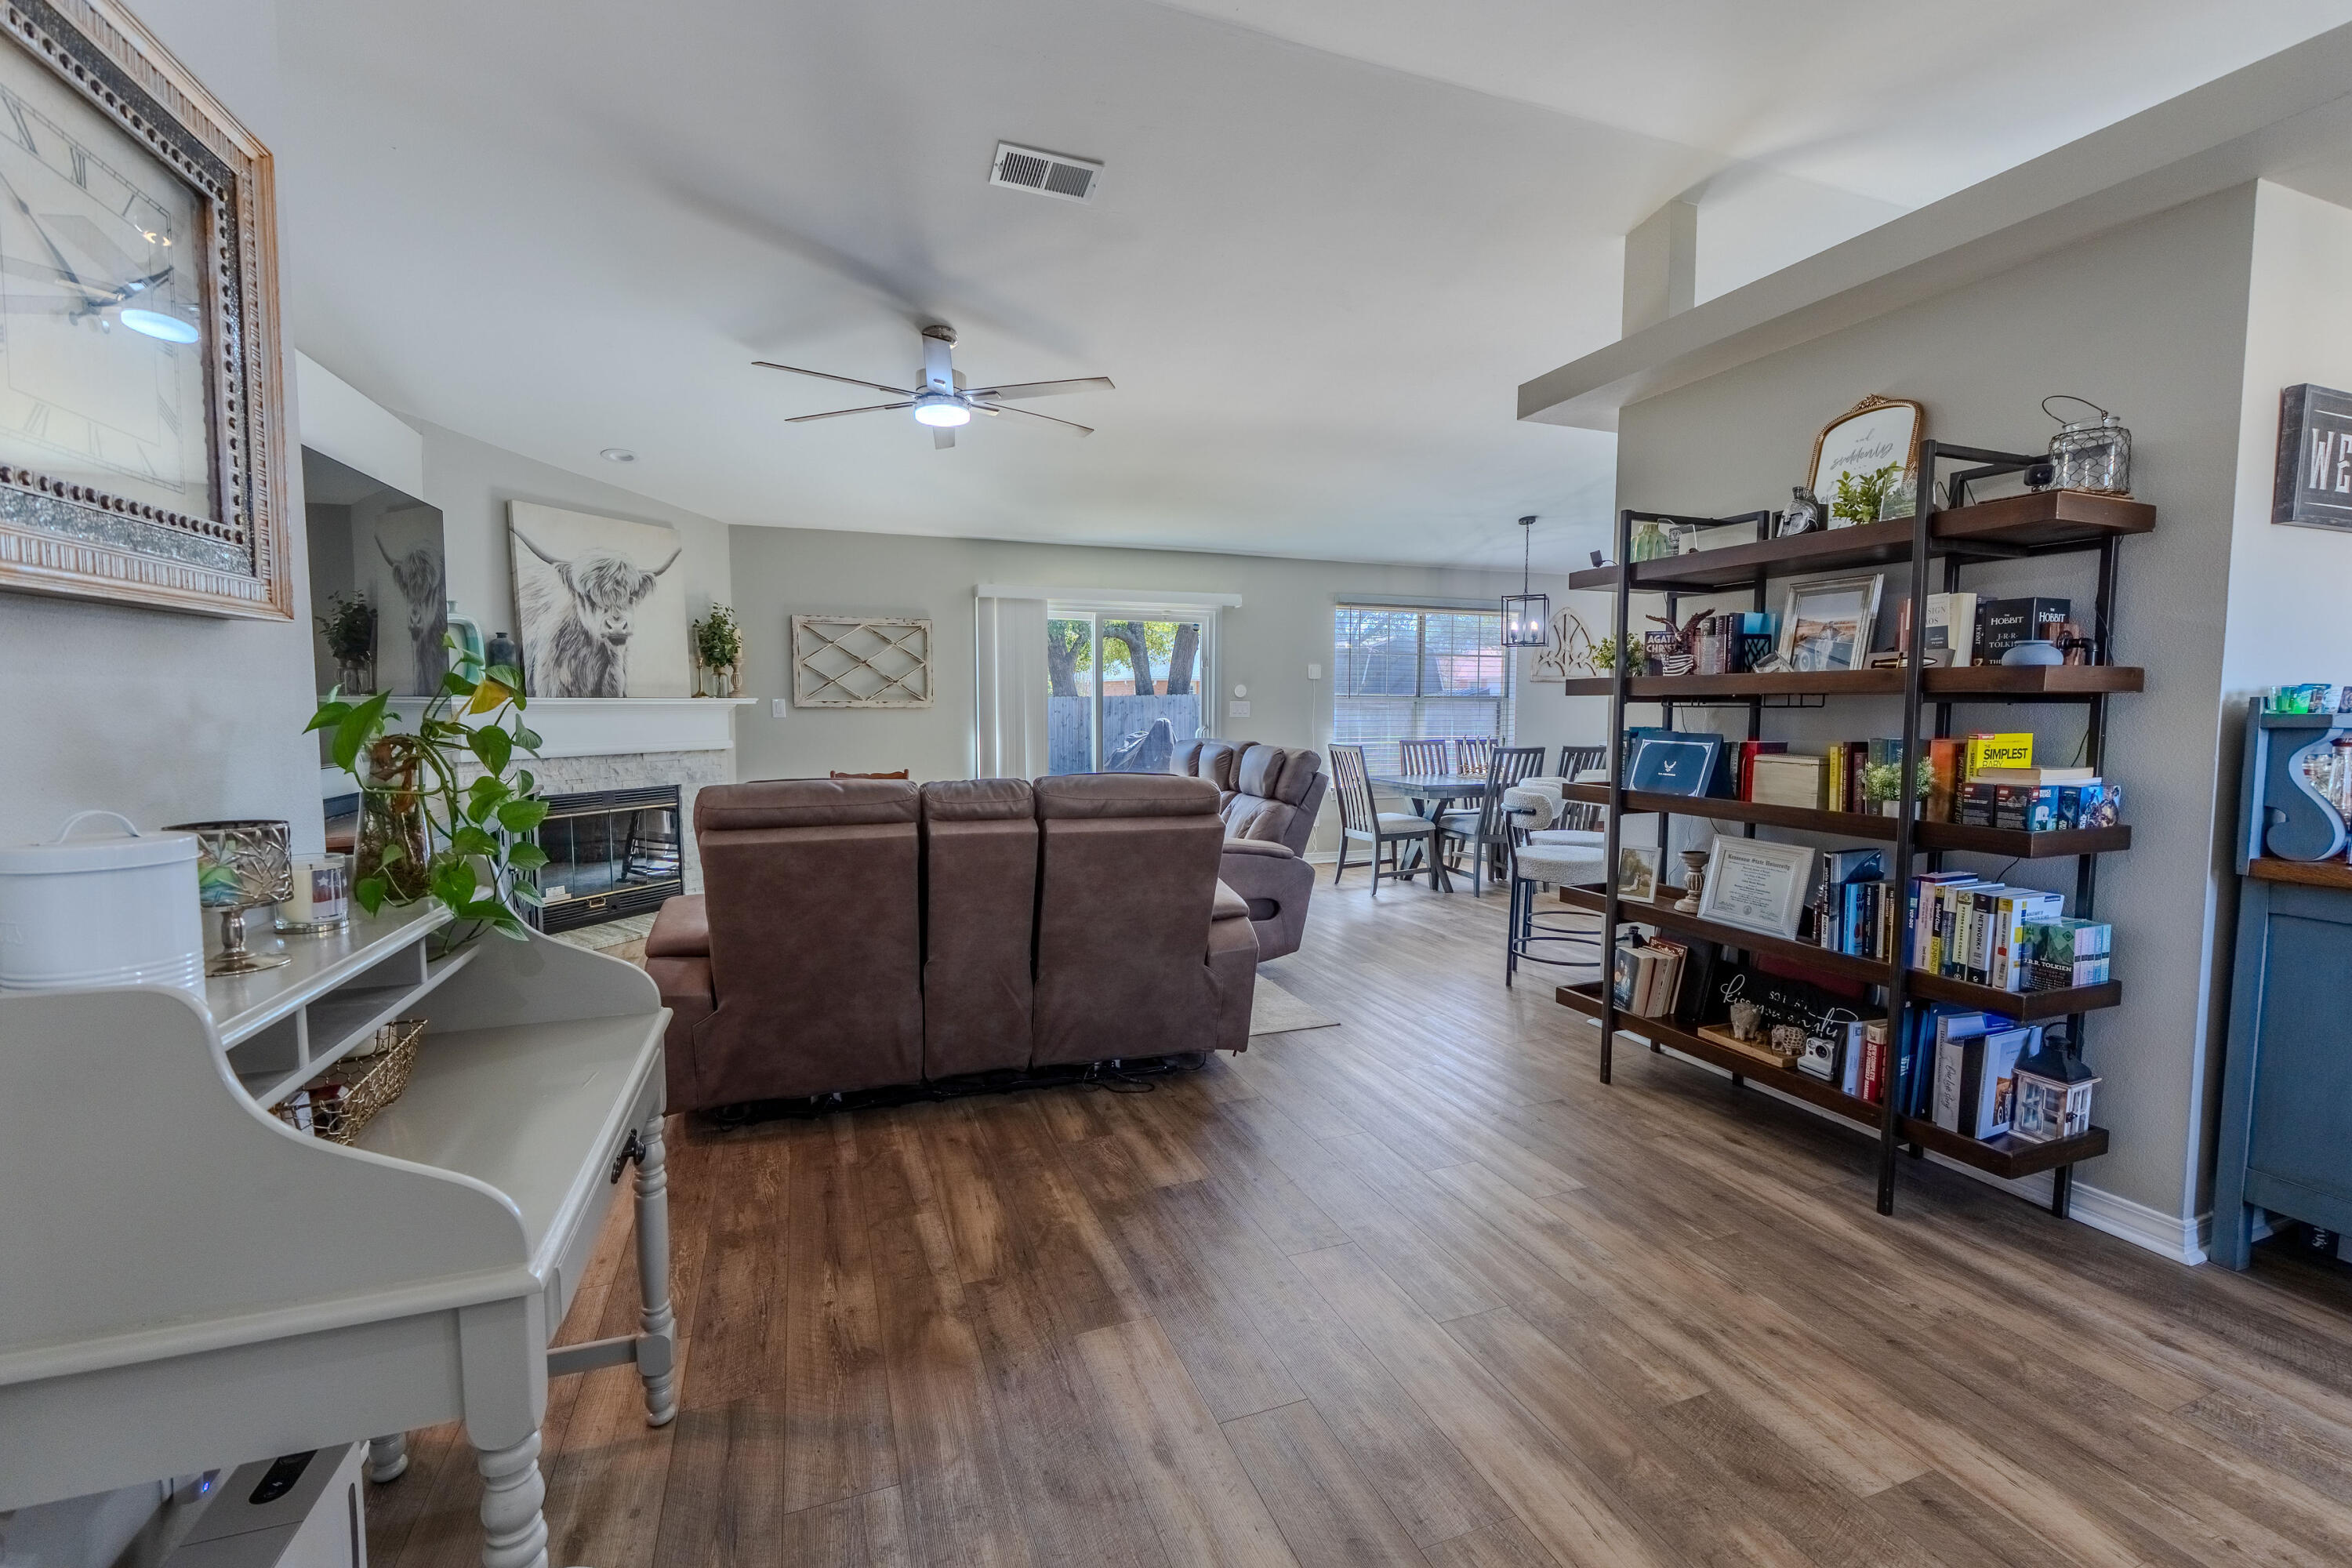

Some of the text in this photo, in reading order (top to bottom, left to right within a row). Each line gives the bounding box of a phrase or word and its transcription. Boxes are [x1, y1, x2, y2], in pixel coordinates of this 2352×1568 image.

[1830, 442, 1894, 470] suddenly
[1991, 616, 2024, 626] HOBBIT
[2038, 612, 2066, 622] HOBBIT
[1984, 747, 2028, 760] SIMPLEST
[1976, 913, 1984, 950] NETWORK+
[2041, 961, 2072, 971] TOLKIEN
